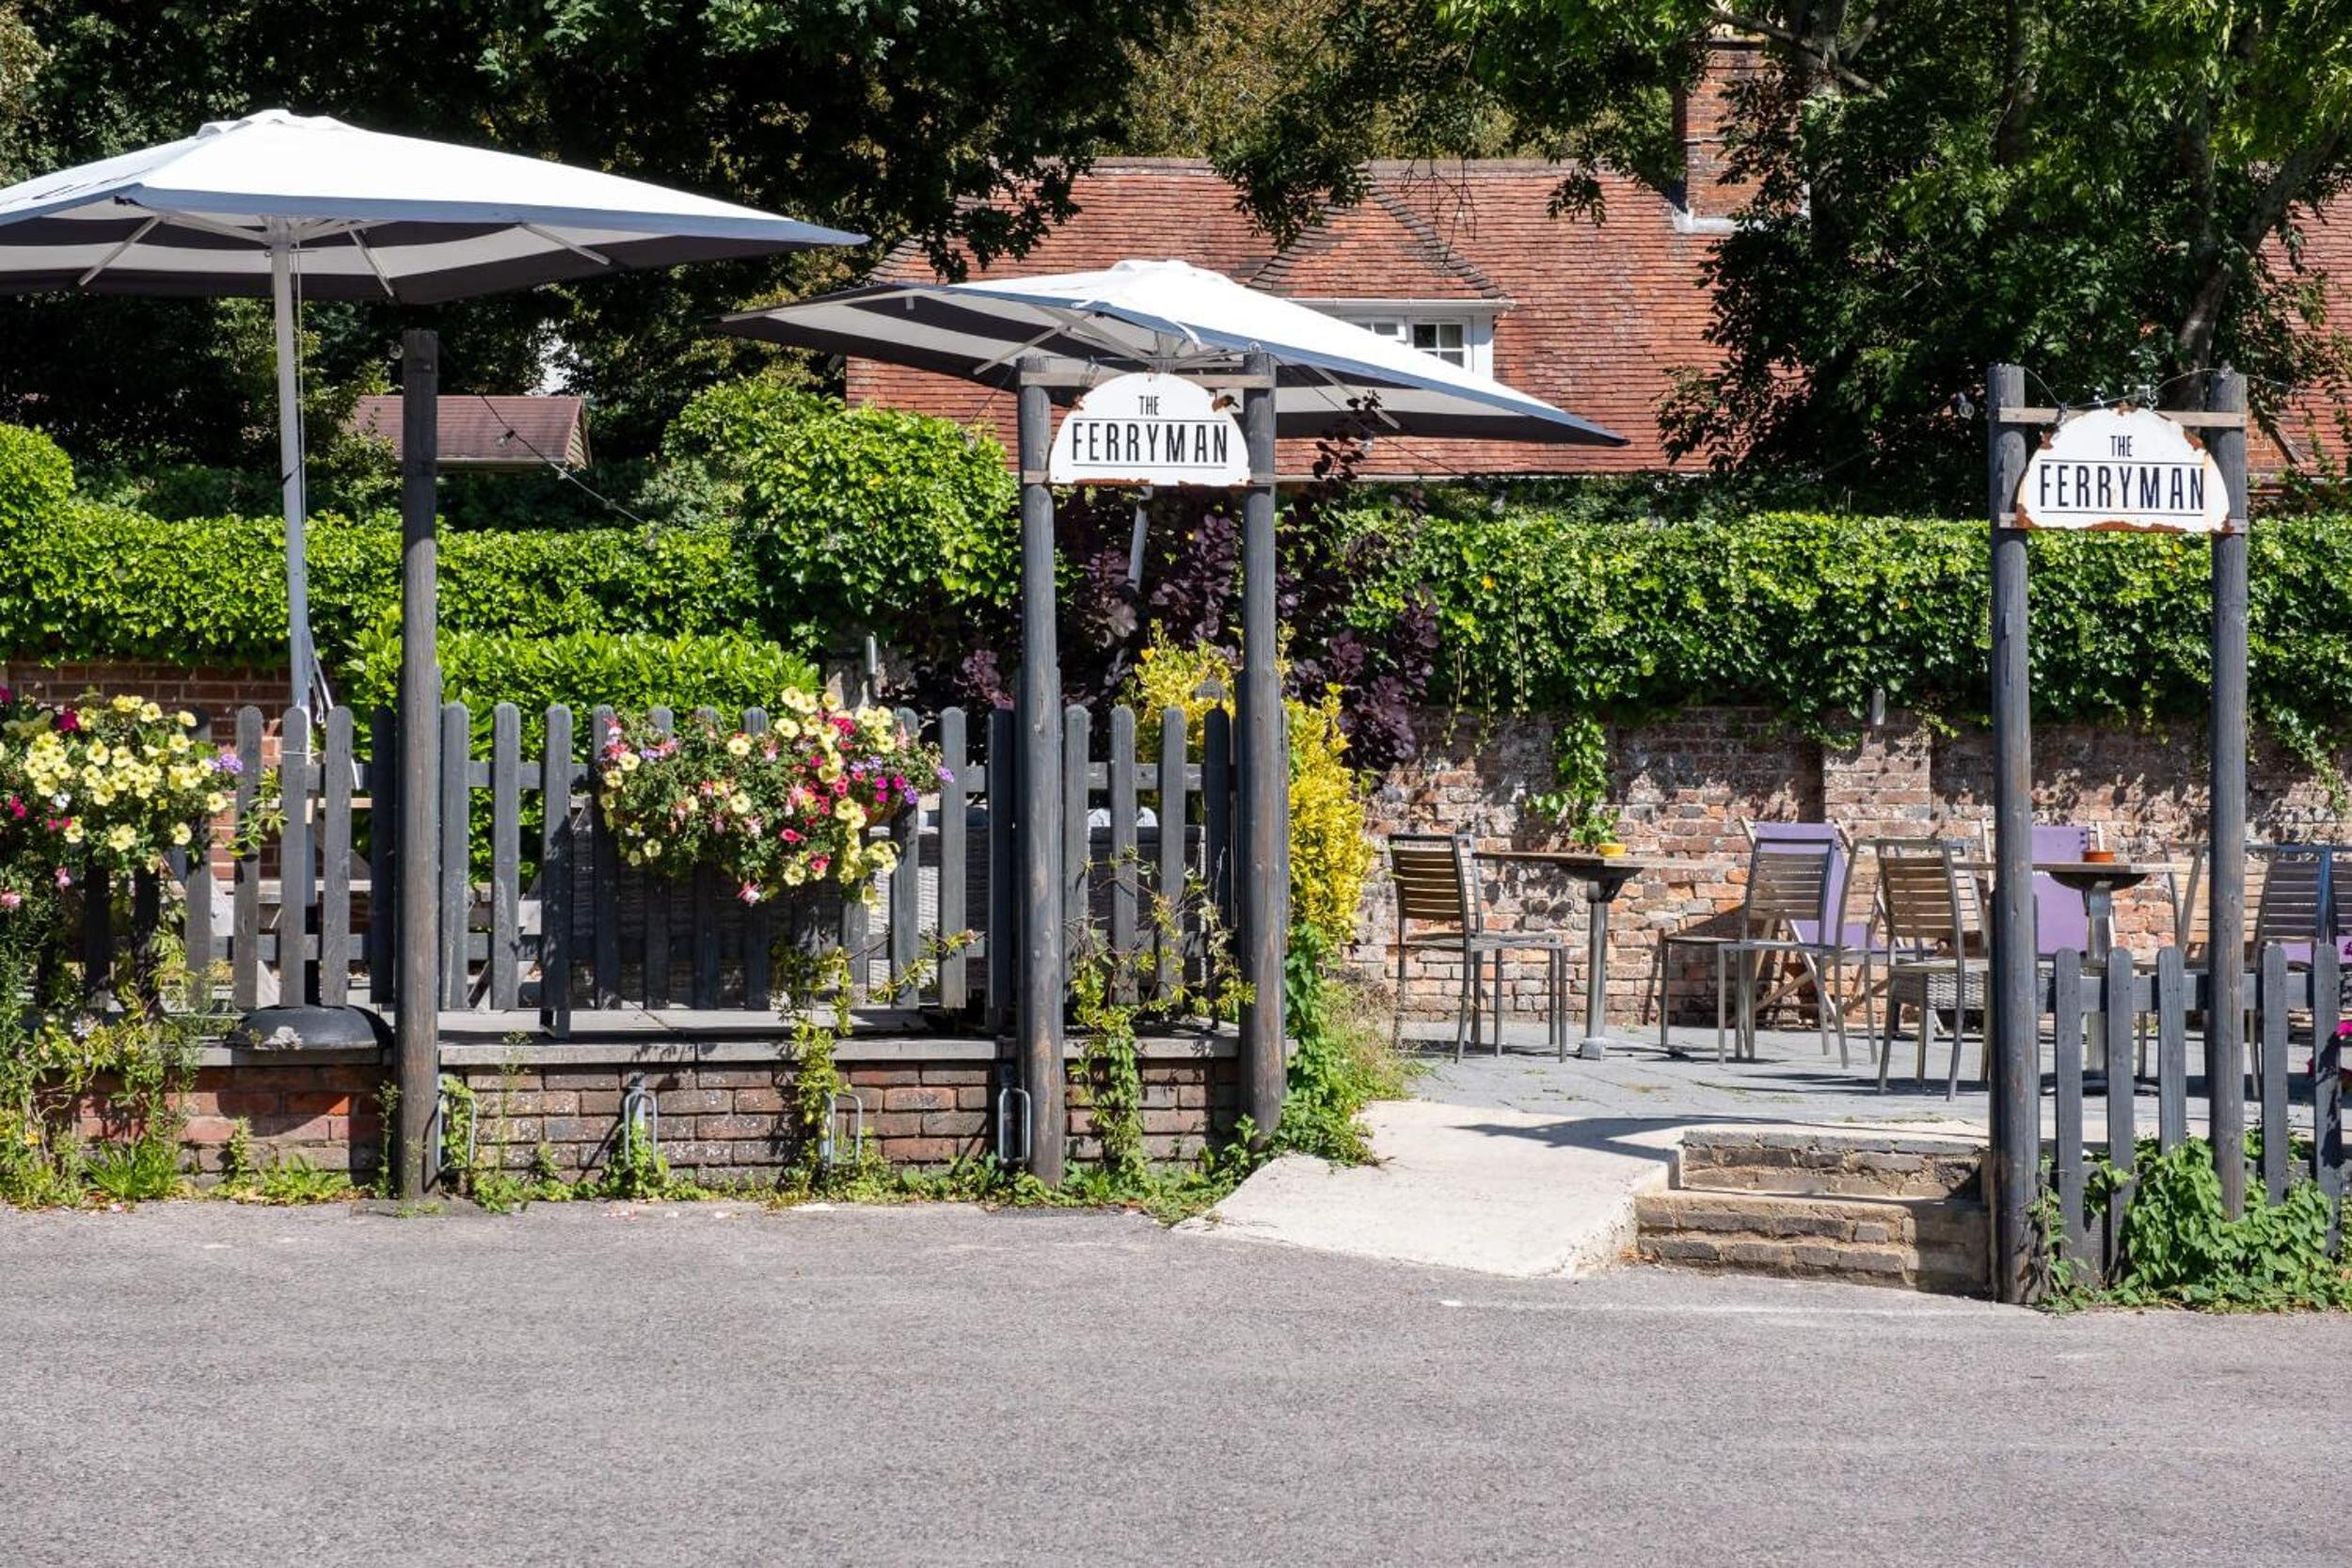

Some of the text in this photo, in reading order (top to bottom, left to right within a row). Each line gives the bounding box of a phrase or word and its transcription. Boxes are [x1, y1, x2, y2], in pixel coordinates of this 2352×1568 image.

[1138, 395, 1160, 416] THE
[1073, 422, 1228, 463] FERRYMAN
[2110, 436, 2133, 457] THE
[2040, 464, 2204, 510] FERRYMAN
